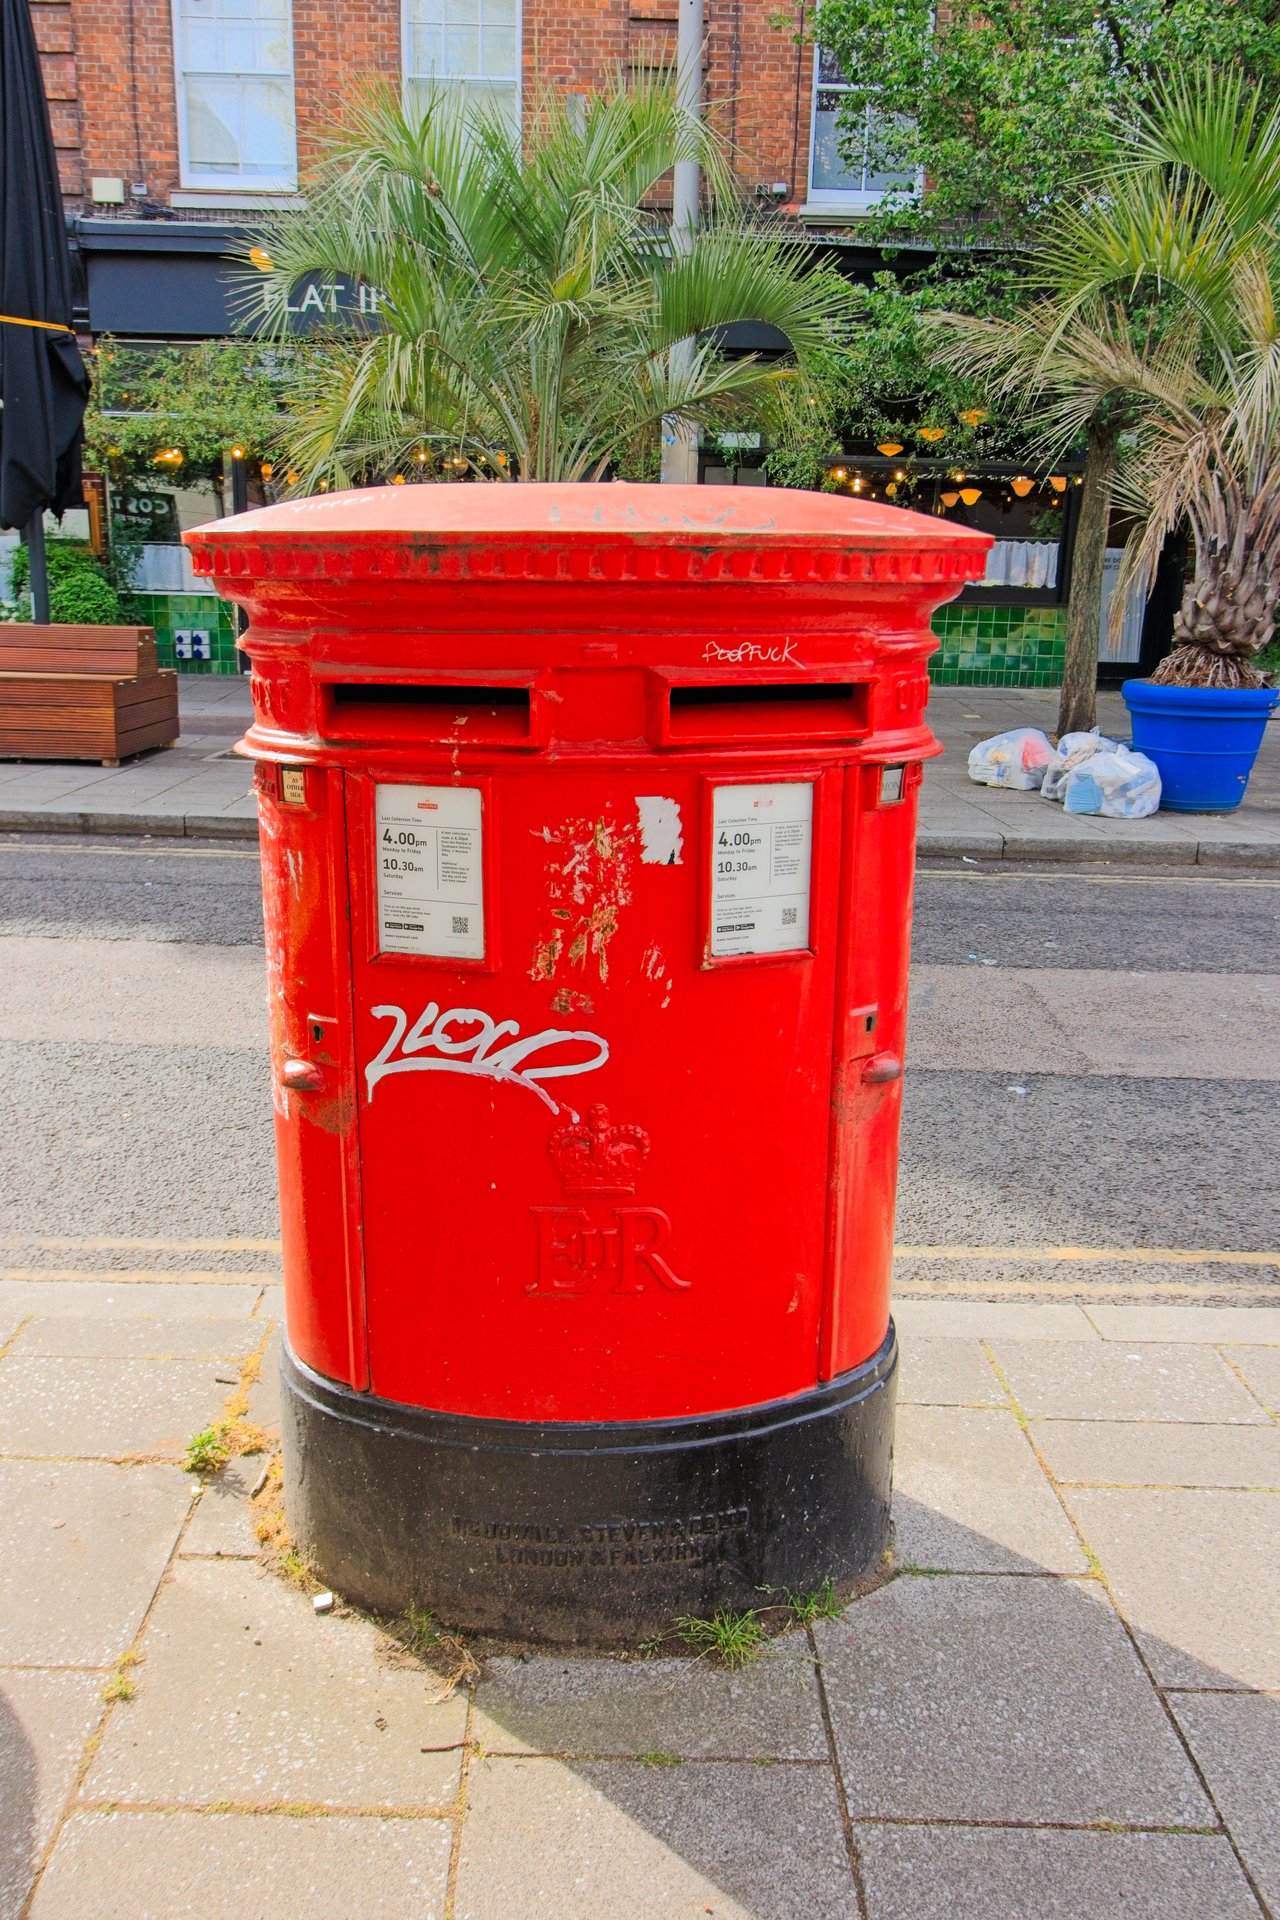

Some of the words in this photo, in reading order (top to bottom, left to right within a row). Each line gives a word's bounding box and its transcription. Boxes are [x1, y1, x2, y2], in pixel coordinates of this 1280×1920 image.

[263, 283, 345, 313] FLAT
[383, 858, 424, 872] 10.30am
[718, 861, 758, 873] 10.30am
[581, 1521, 665, 1543] STEVEN
[671, 1518, 685, 1538] &
[496, 1545, 586, 1567] LONDON
